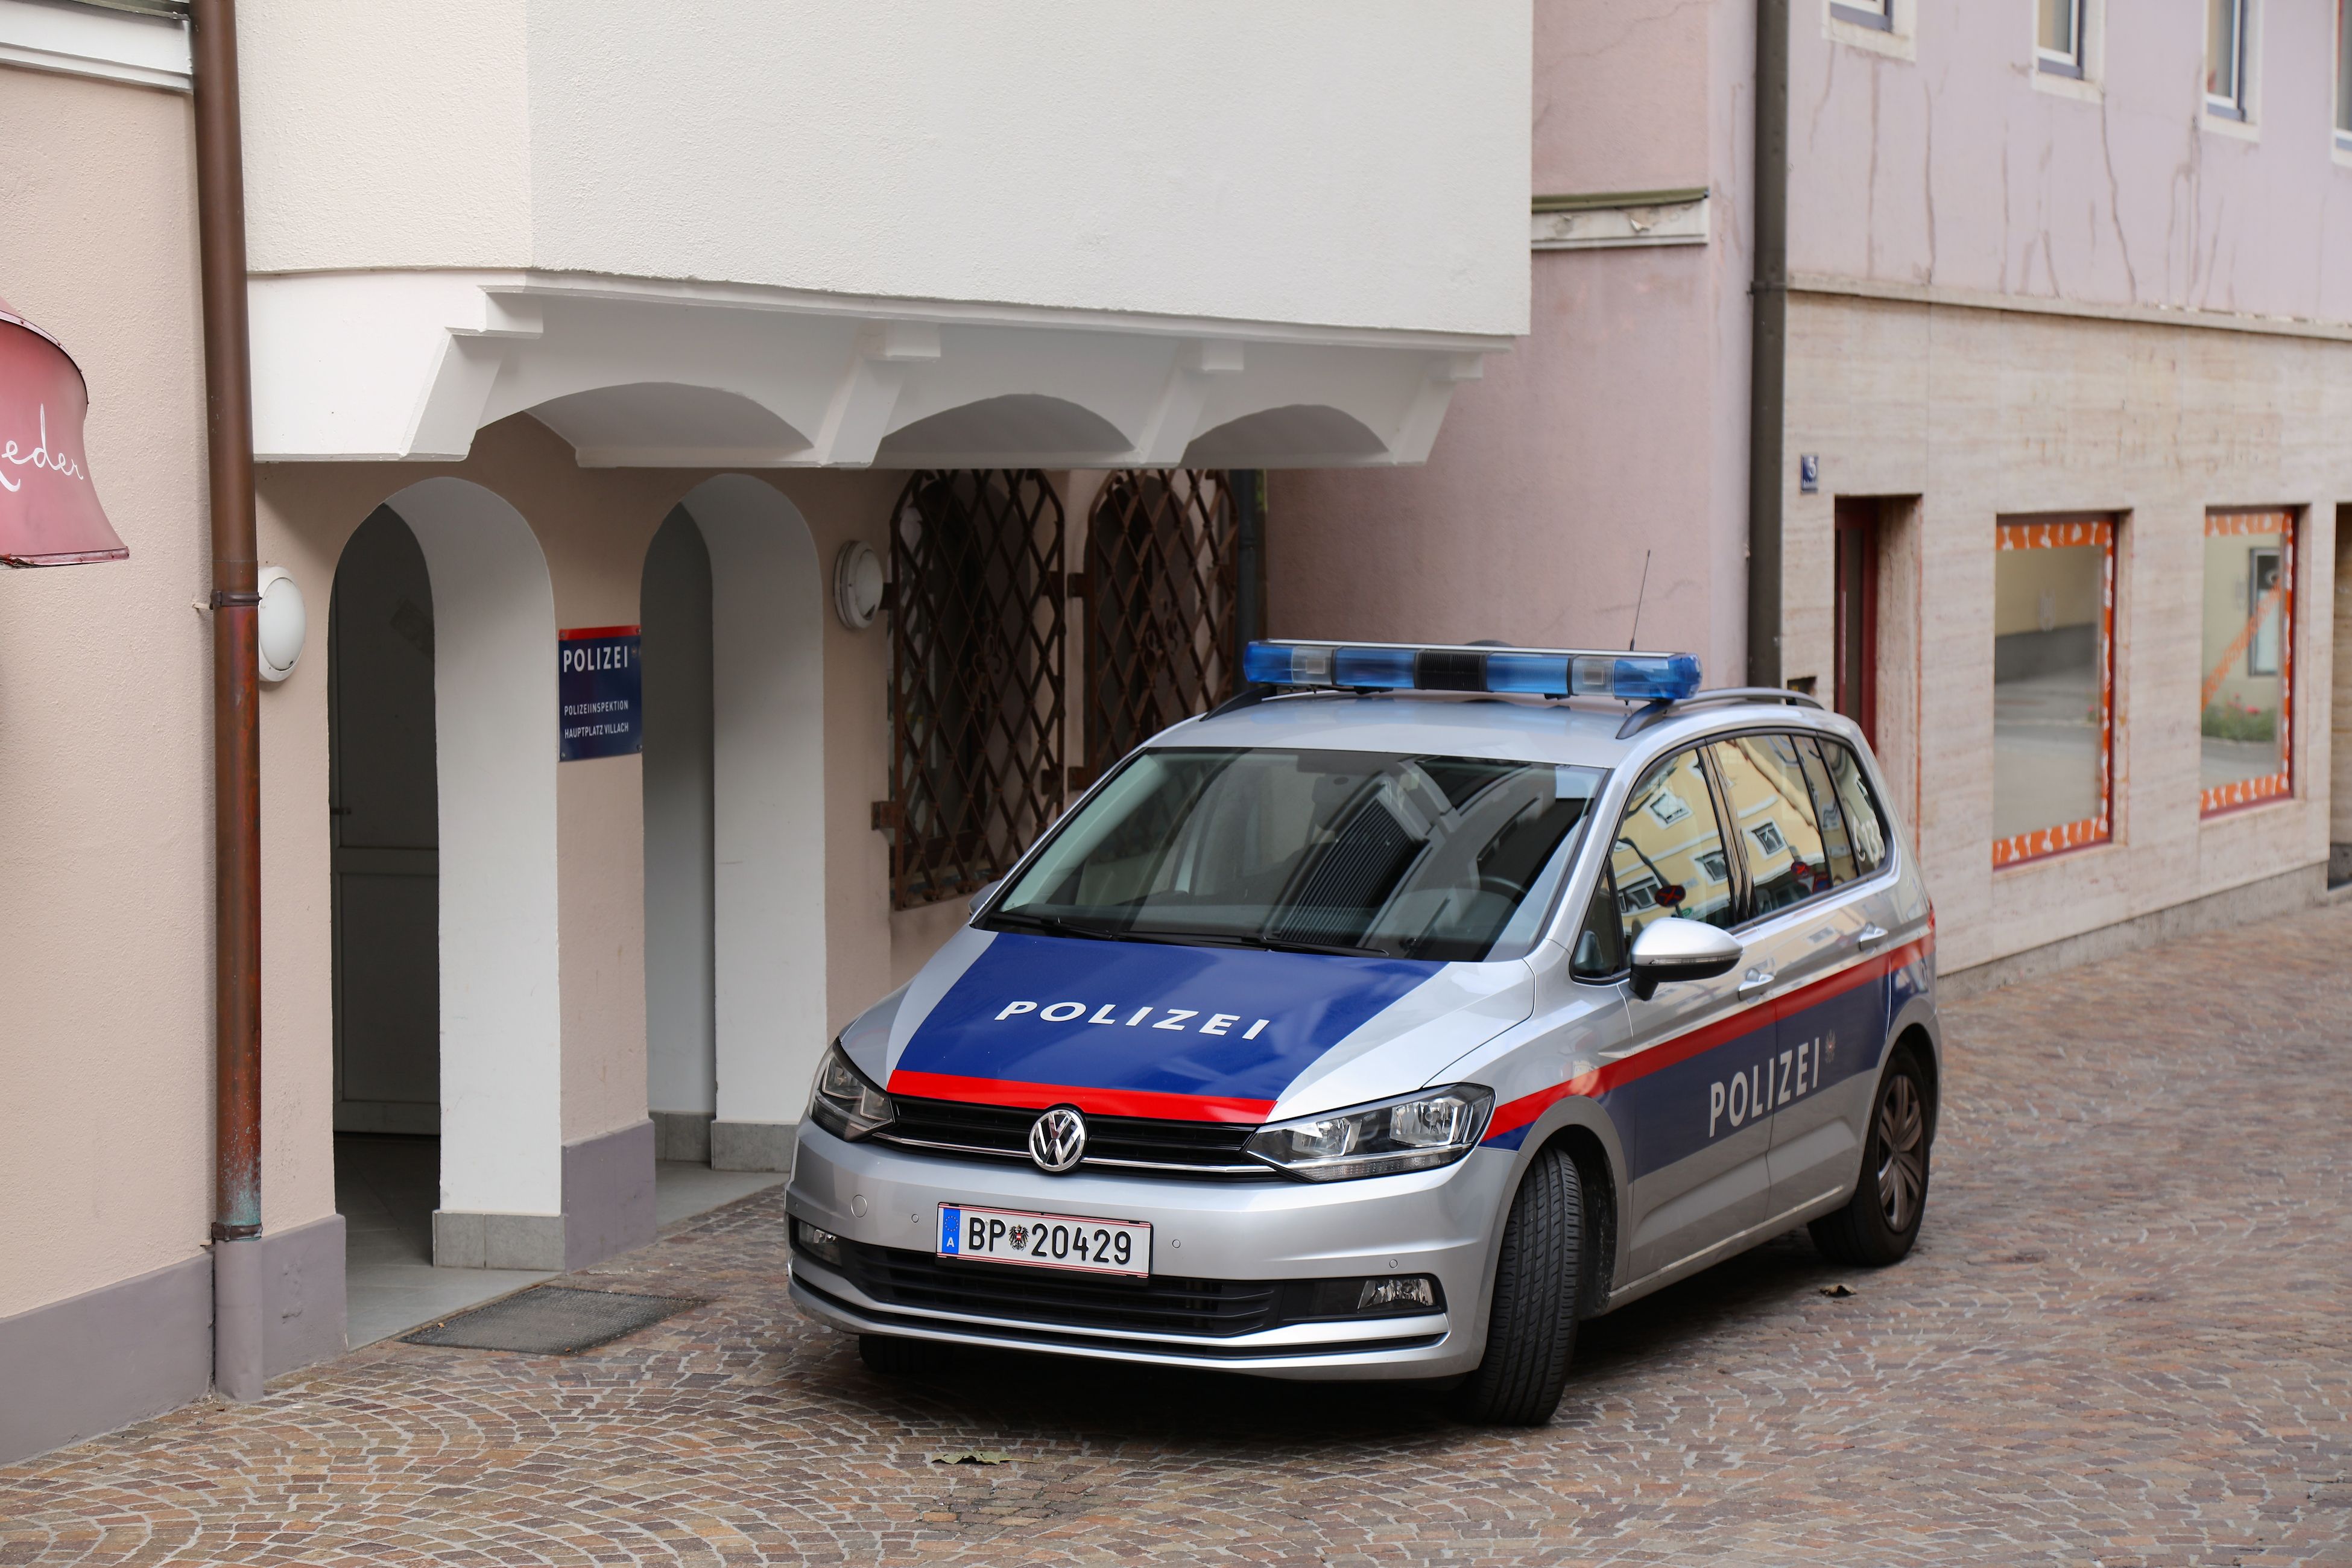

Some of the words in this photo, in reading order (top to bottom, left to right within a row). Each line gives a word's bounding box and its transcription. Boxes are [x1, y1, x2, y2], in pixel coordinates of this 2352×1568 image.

[563, 645, 628, 673] POLIZEI
[564, 700, 628, 716] POLIZEIINSPEKTION
[564, 724, 603, 739] HAUPTPLATZ
[604, 722, 628, 734] VILLACH
[994, 1001, 1270, 1040] POLIZEI
[1709, 1037, 1819, 1138] POLIZEI
[946, 1236, 955, 1248] A
[969, 1216, 1006, 1252] BP
[1031, 1222, 1131, 1265] 20429
